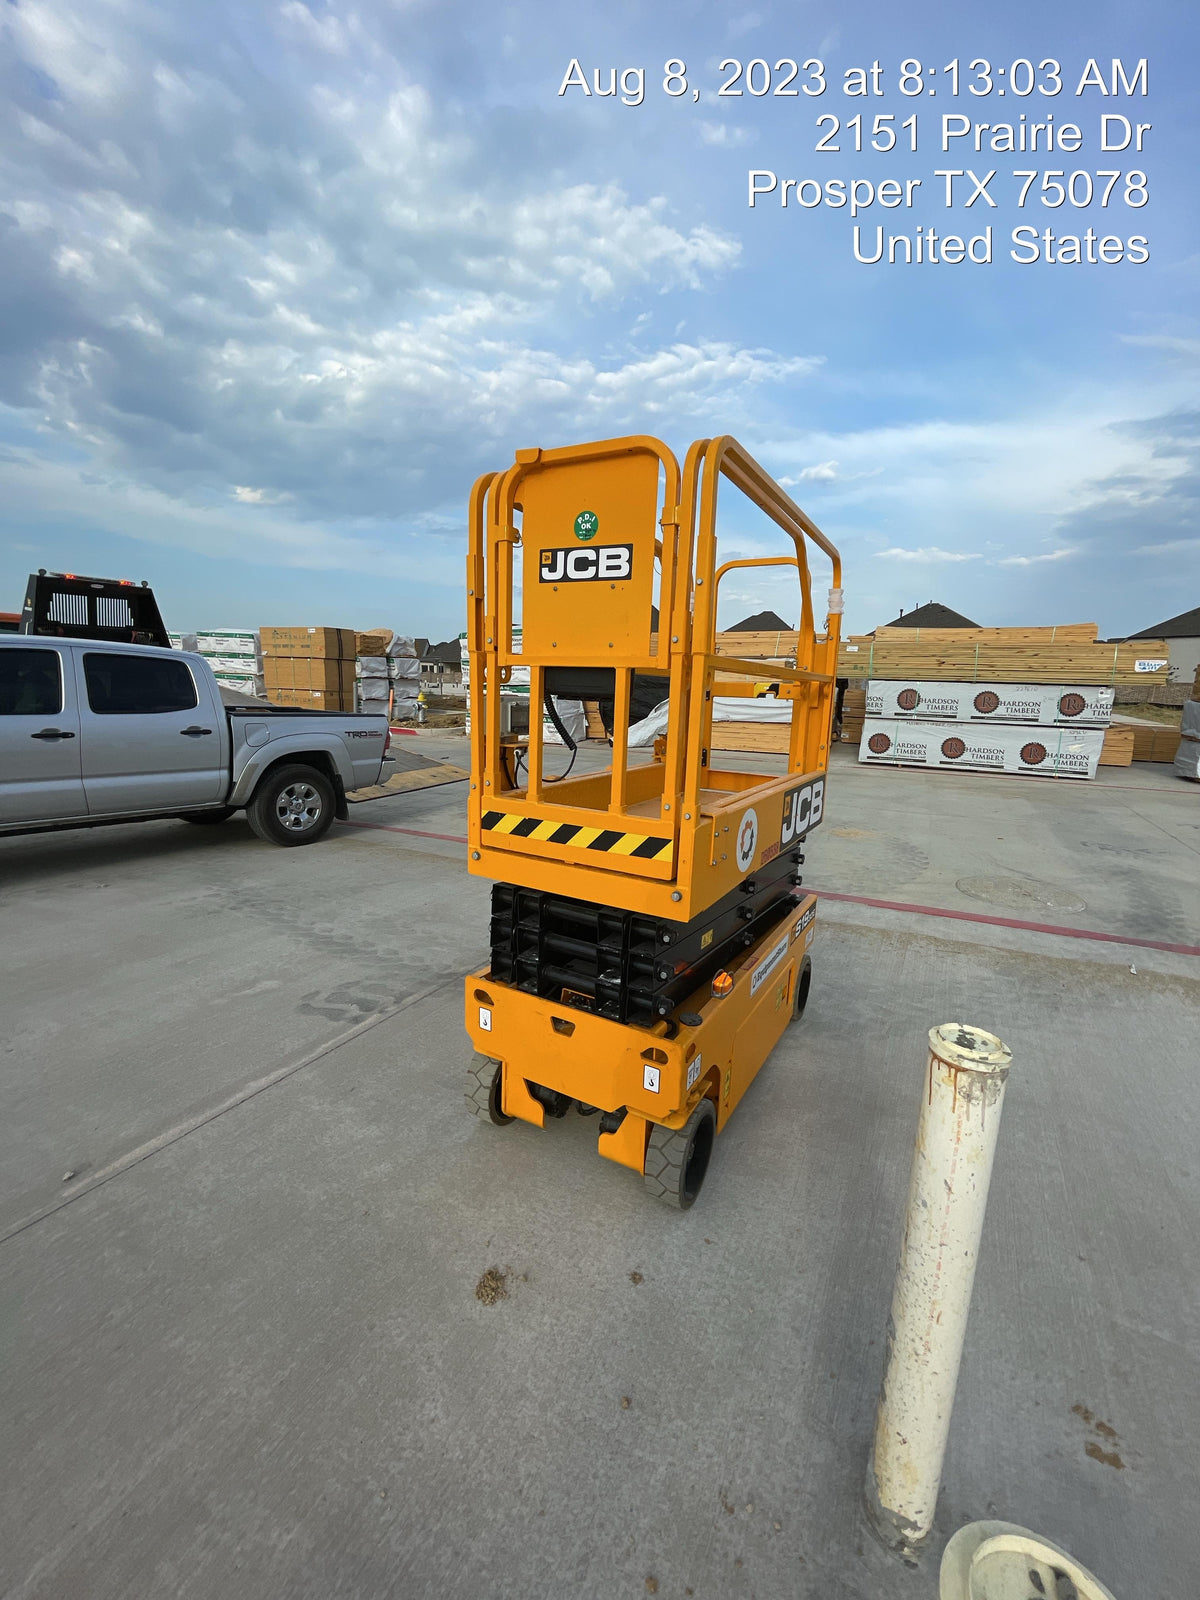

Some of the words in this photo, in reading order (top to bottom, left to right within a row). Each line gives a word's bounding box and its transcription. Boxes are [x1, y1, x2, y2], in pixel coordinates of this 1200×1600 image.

[580, 522, 592, 530] OK
[541, 547, 630, 581] JCB
[344, 730, 368, 739] TRD
[971, 753, 1004, 761] TIMBERS
[1052, 759, 1089, 768] TIMBERS
[782, 780, 824, 844] JCB
